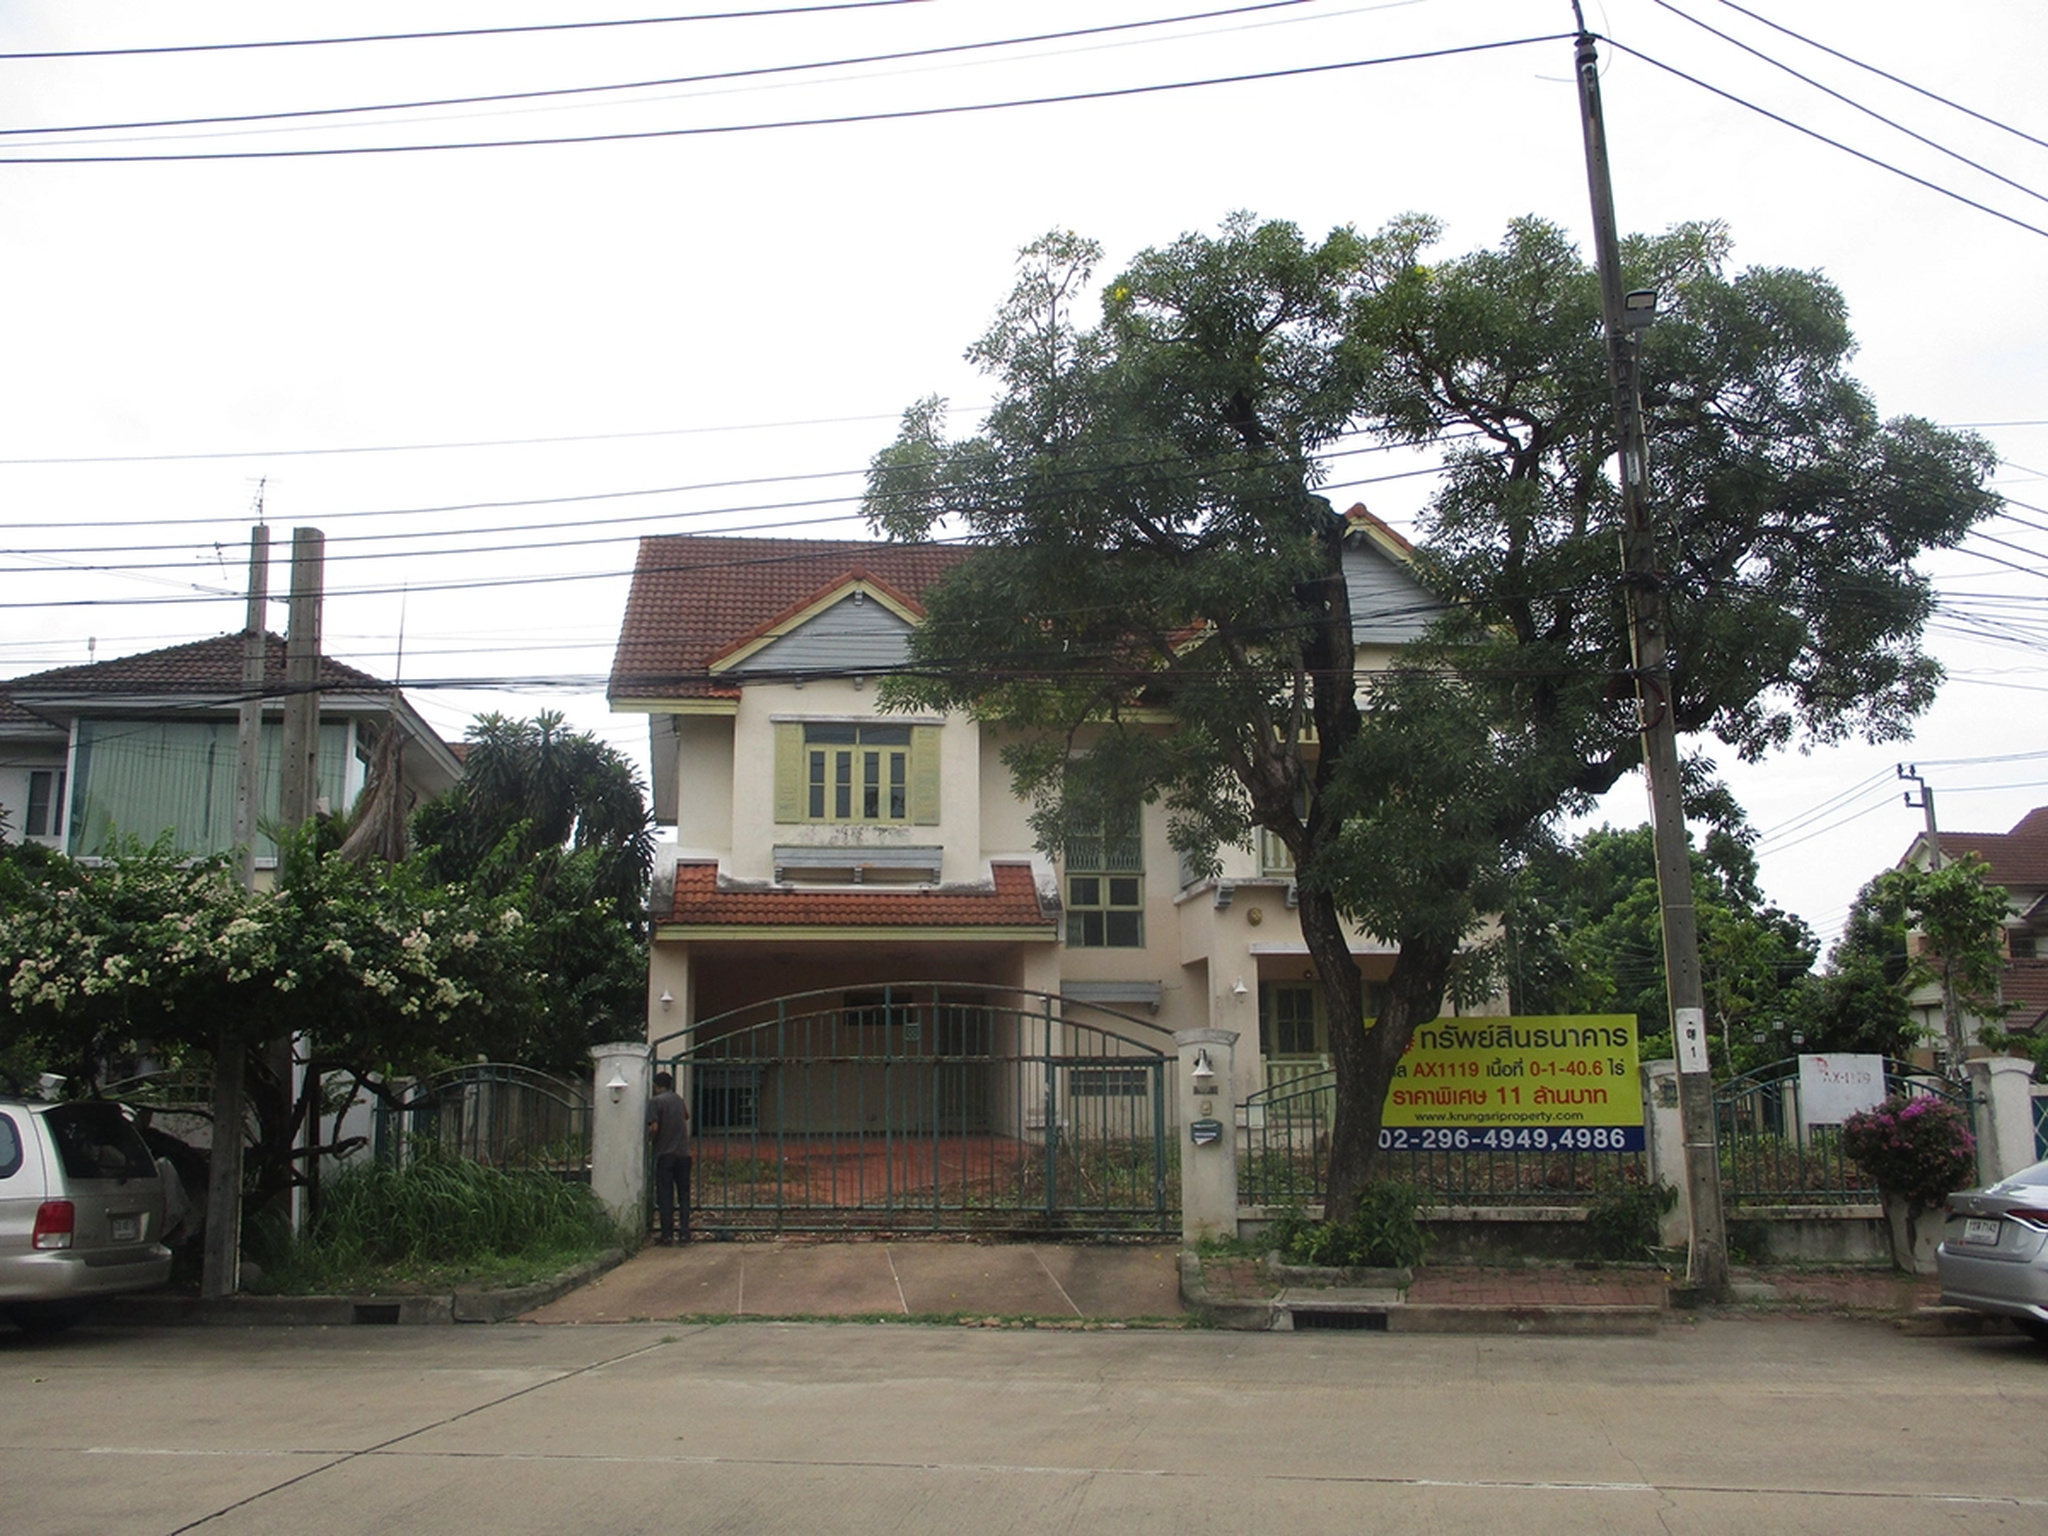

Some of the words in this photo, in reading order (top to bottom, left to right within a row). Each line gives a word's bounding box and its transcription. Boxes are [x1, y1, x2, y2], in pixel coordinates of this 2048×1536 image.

[1420, 1023, 1629, 1050] ทรัพย์สินธนาคาร
[1412, 1061, 1479, 1078] AX1119
[1486, 1057, 1524, 1077] เนื้อที่
[1529, 1060, 1604, 1077] 0-1-40.6
[1607, 1057, 1626, 1076] ไร่
[1392, 1086, 1488, 1106] ราคาพิเศษ
[1496, 1085, 1521, 1105] 11
[1533, 1085, 1608, 1105] ล้านบาท
[1414, 1111, 1584, 1123] www.krungsriproperty.com
[1378, 1128, 1626, 1151] 02-296-4949,4986
